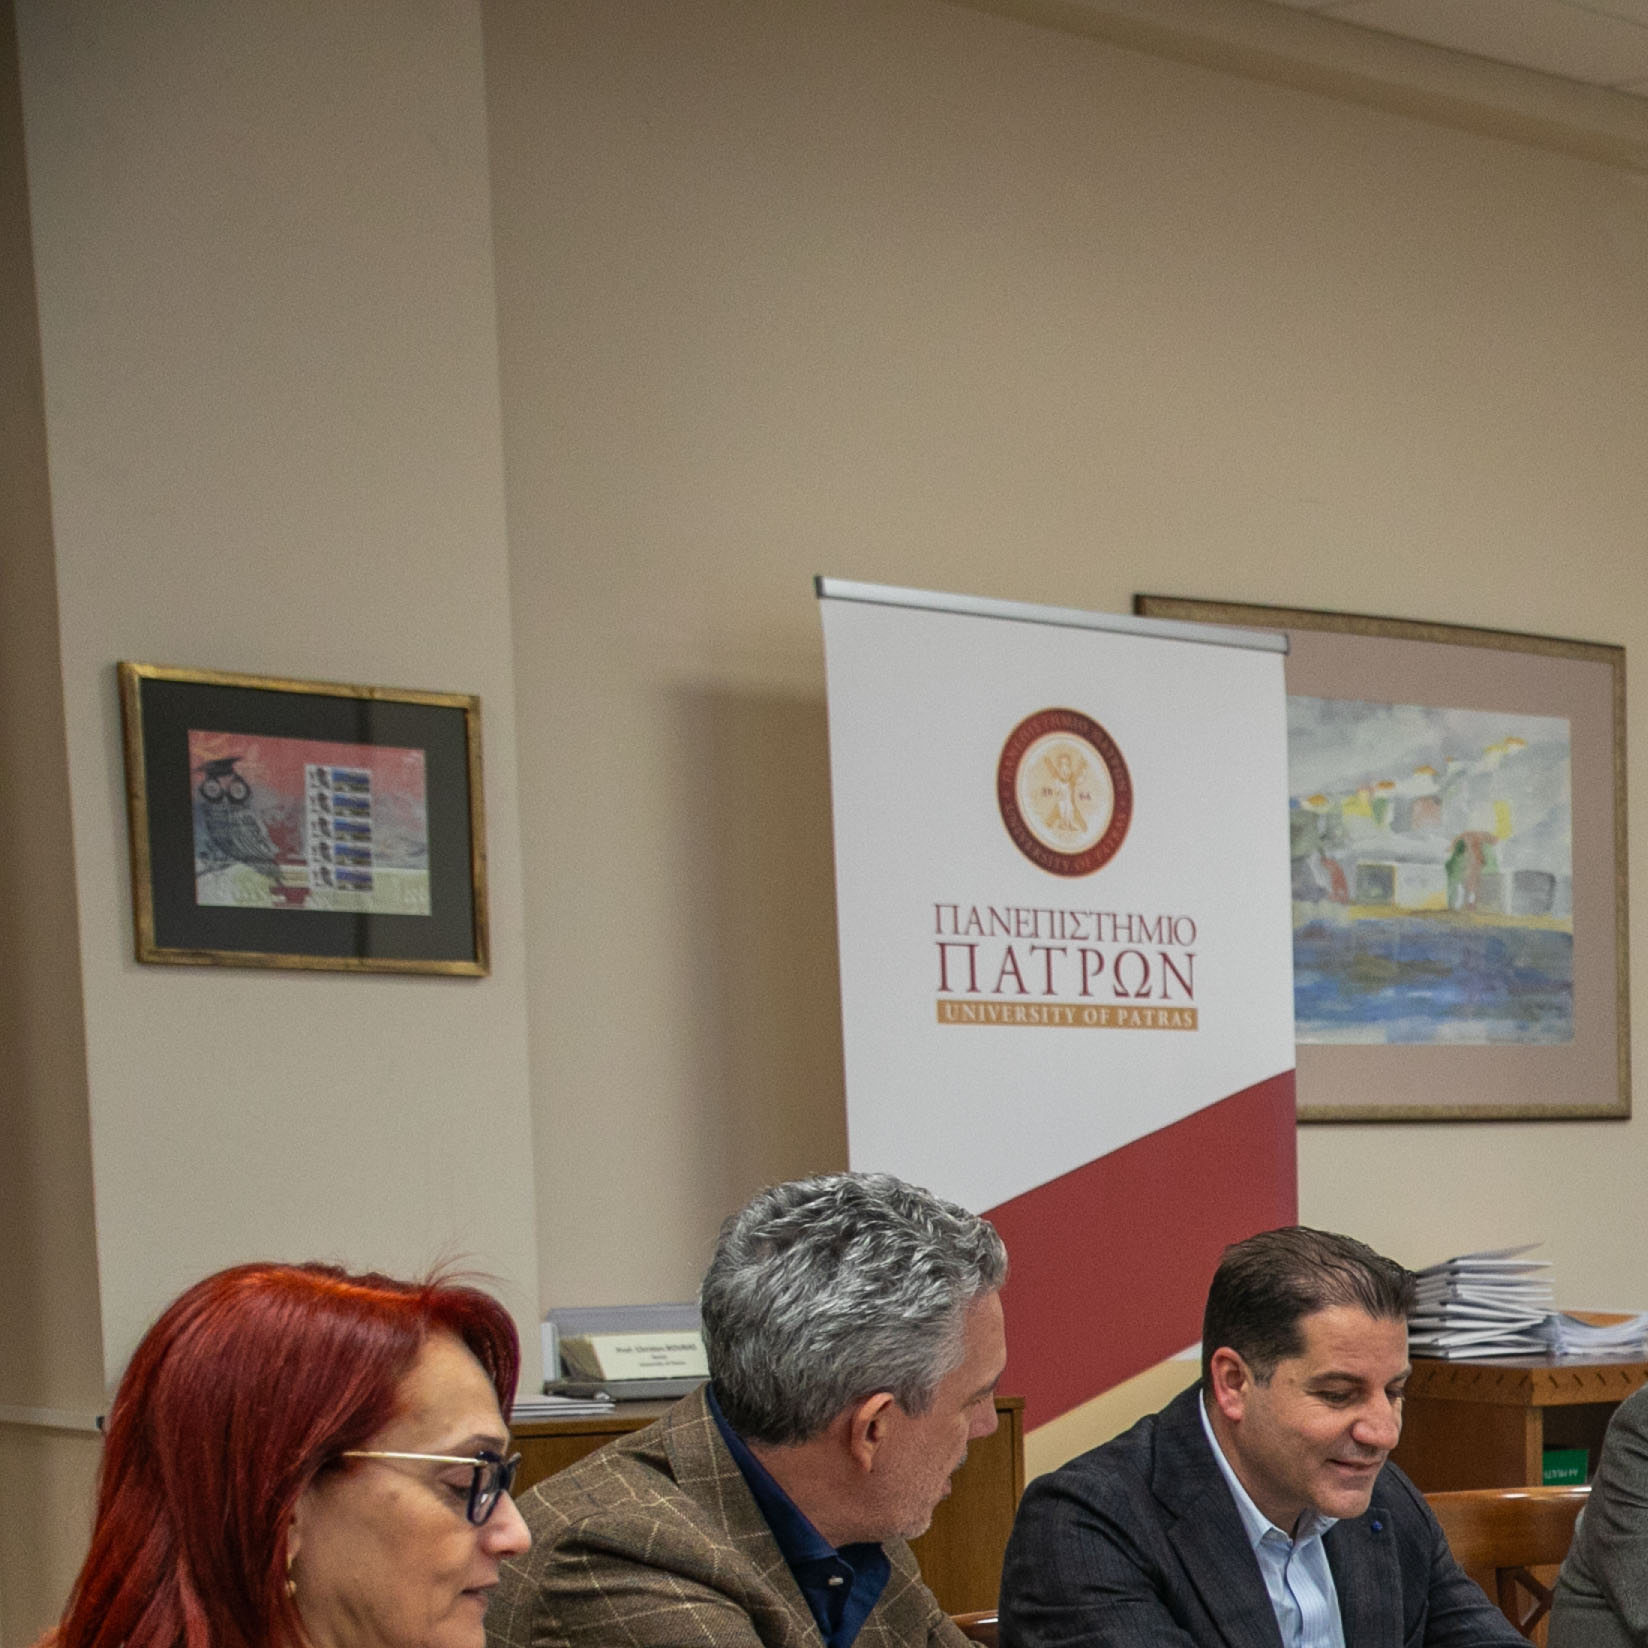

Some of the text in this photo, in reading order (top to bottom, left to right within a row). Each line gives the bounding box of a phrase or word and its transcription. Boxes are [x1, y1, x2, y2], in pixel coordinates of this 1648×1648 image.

[935, 903, 1197, 946] ΠΑΝΕΠΙΣΤΗΜΙΟ
[936, 942, 1197, 1000] ΠΑΤΡΩΝ
[944, 1003, 1193, 1028] UNIVERSITY OF PATRAS
